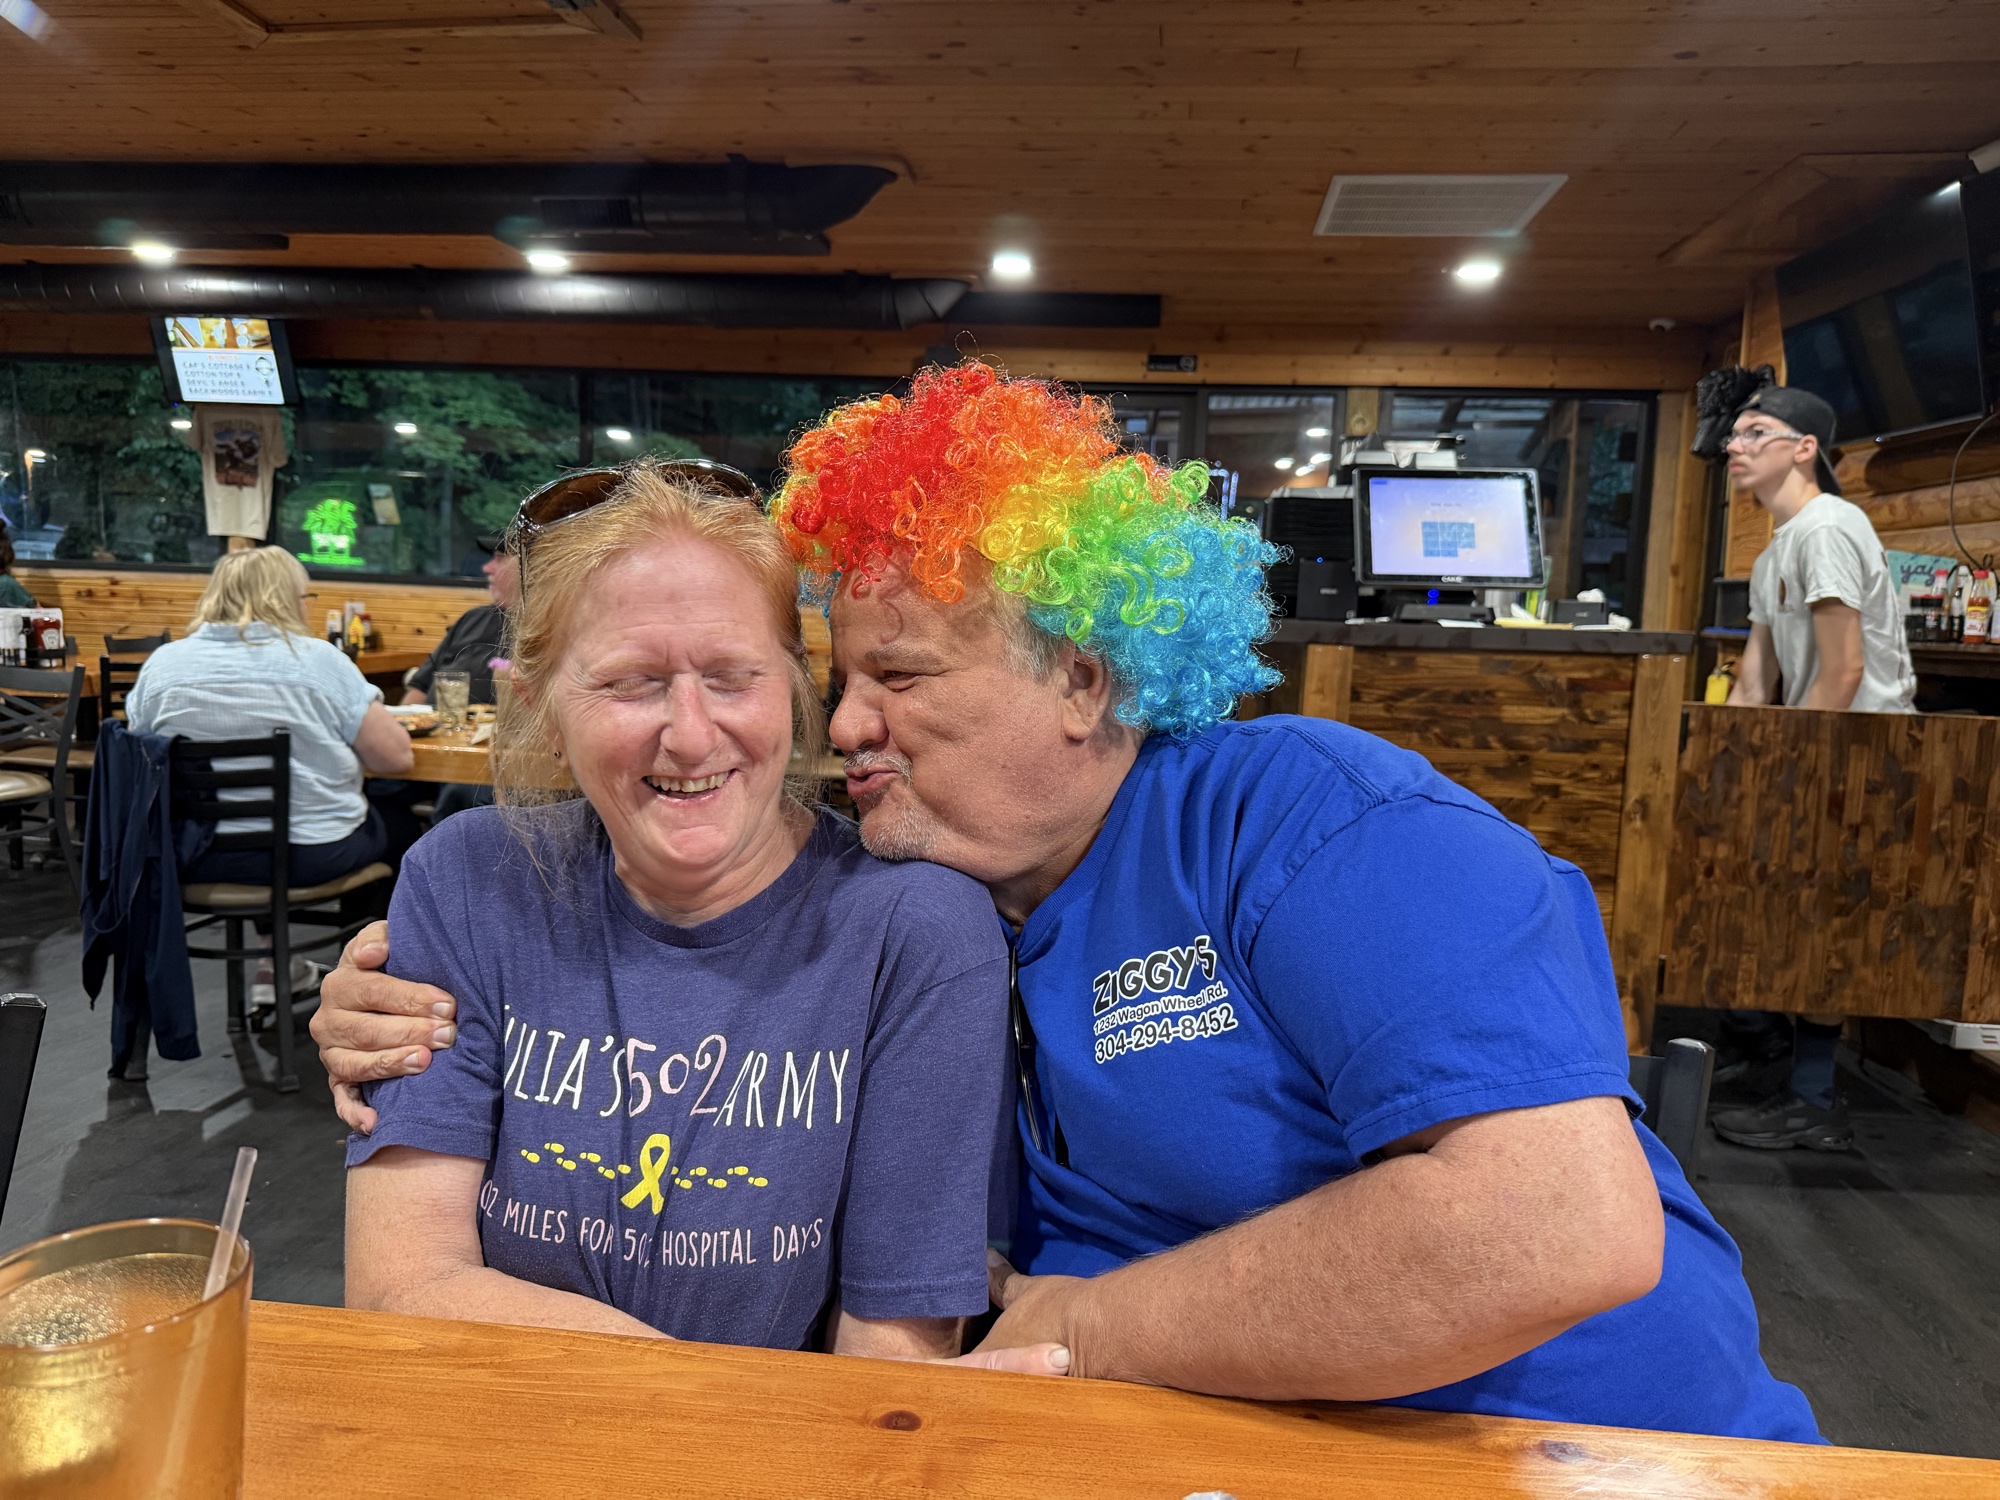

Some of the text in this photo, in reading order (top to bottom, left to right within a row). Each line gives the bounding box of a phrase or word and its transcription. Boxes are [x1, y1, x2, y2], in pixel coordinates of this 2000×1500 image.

[184, 370, 217, 378] COTTON
[1094, 981, 1228, 1036] 1232 Wagon Wheel Rd.
[1095, 1003, 1238, 1064] 304-294-8452
[625, 1034, 728, 1119] 502
[712, 1048, 850, 1130] ARMY
[502, 1197, 568, 1244] MILES
[580, 1216, 615, 1255] FOR
[662, 1227, 758, 1268] HOSPITAL
[773, 1217, 823, 1263] DAYS
